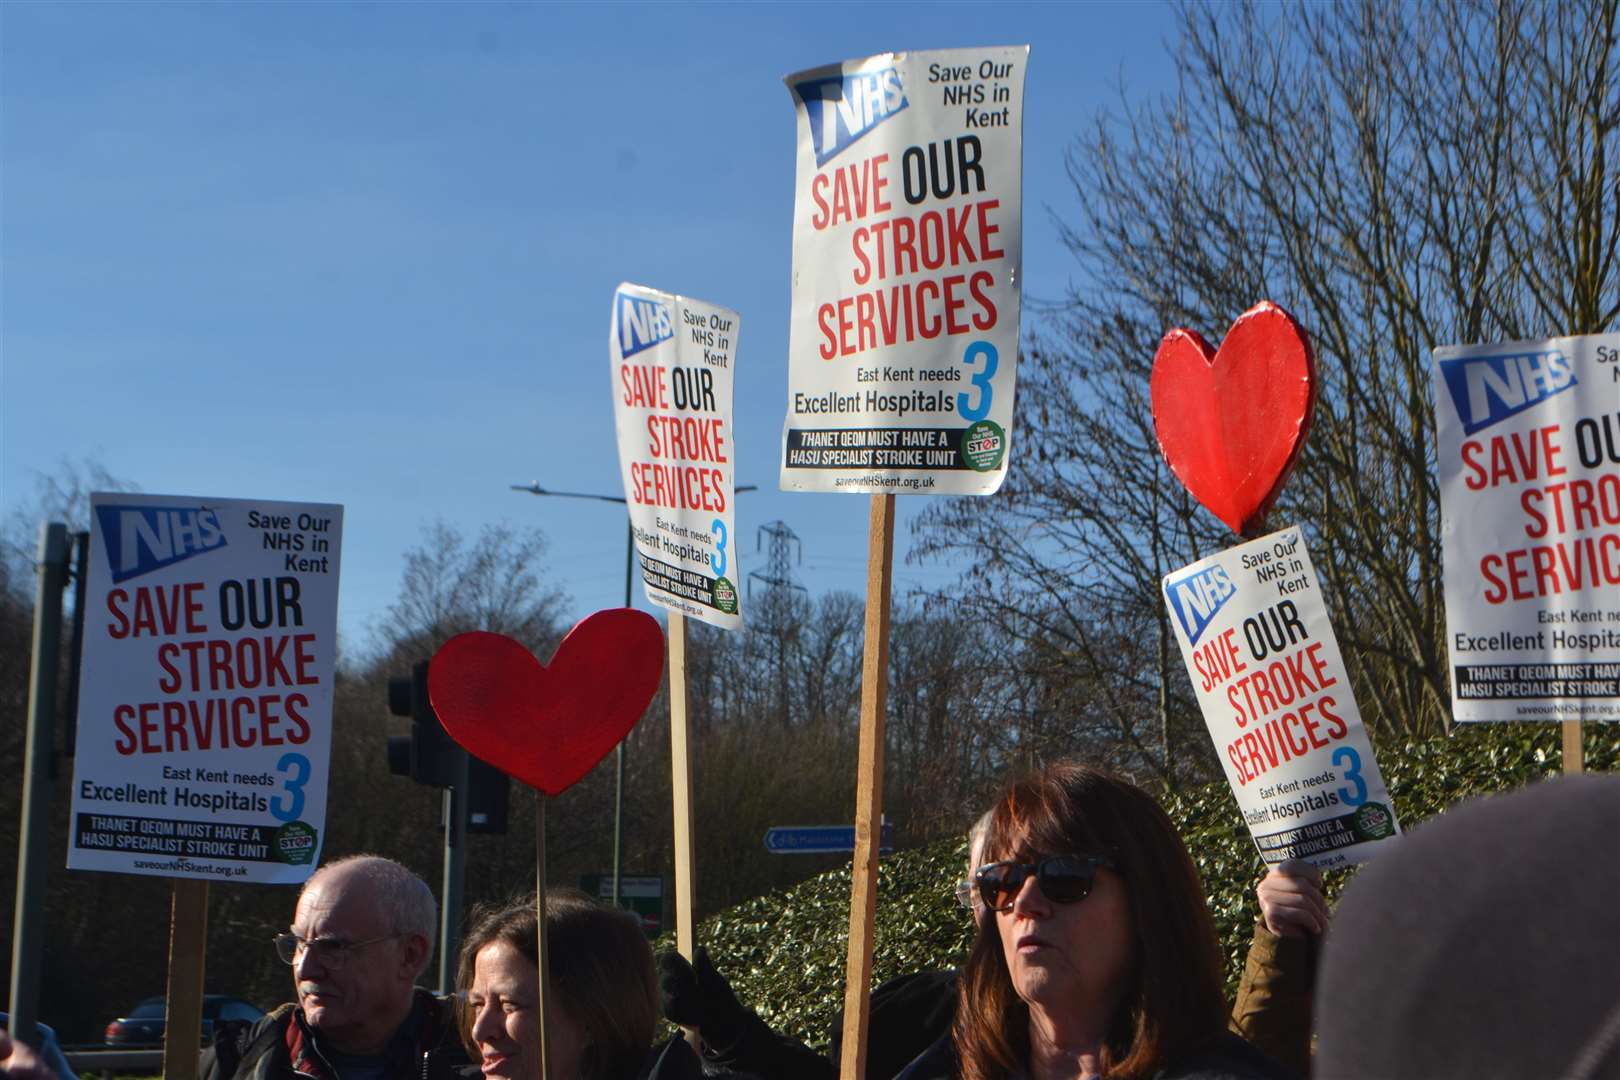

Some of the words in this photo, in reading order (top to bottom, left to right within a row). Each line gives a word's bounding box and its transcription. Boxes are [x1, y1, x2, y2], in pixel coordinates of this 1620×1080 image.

[928, 62, 975, 84] Save
[978, 59, 1014, 81] Our
[943, 84, 985, 107] NHS
[992, 82, 1010, 104] in
[819, 70, 904, 155] NHS
[966, 106, 1009, 130] Kent
[811, 153, 892, 230] SAVE
[903, 134, 987, 206] OUR
[852, 199, 1005, 287] STROKE
[622, 300, 672, 352] NHS
[683, 309, 707, 328] Save
[710, 315, 732, 333] Our
[818, 270, 998, 362] SERVICES
[691, 328, 714, 348] NHS
[719, 334, 729, 350] in
[704, 349, 728, 368] Kent
[1597, 345, 1618, 363] Sa
[857, 367, 879, 382] East
[883, 366, 914, 382] Kent
[919, 366, 961, 382] needs
[956, 340, 998, 422] 3
[1469, 352, 1572, 424] NHS
[621, 365, 669, 410] SAVE
[672, 367, 716, 412] OUR
[794, 392, 861, 414] Excellent
[866, 389, 954, 417] Hospitals
[647, 415, 727, 463] STROKE
[800, 432, 839, 448] THANET
[841, 431, 866, 447] QEQM
[868, 431, 899, 447] MUST
[902, 431, 936, 447] HAVE
[938, 431, 948, 447] A
[968, 438, 999, 453] STOP
[1460, 424, 1567, 491] SAVE
[1575, 412, 1620, 469] OU
[790, 450, 820, 465] HASU
[822, 450, 874, 466] SPECIALIST
[876, 450, 923, 466] STROKE
[926, 450, 957, 466] UNIT
[631, 462, 726, 513] SERVICES
[1520, 473, 1620, 539] STRO
[248, 510, 292, 531] Save
[296, 512, 330, 533] Our
[656, 517, 669, 531] East
[670, 521, 688, 537] Kent
[690, 530, 712, 545] needs
[119, 508, 223, 573] NHS
[263, 533, 305, 552] NHS
[312, 536, 329, 553] in
[663, 535, 710, 565] Hospitals
[710, 519, 727, 577] 3
[284, 554, 329, 574] Kent
[1241, 551, 1271, 569] Save
[1273, 543, 1297, 558] Our
[1480, 533, 1620, 605] SERVIC
[683, 570, 702, 587] HAVE
[703, 577, 709, 590] A
[1256, 562, 1286, 584] NHS
[1289, 559, 1303, 573] in
[1277, 574, 1310, 596] Kent
[671, 580, 697, 599] STROKE
[698, 588, 712, 605] UNIT
[1176, 565, 1234, 636] NHS
[107, 582, 207, 640] SAVE
[219, 576, 303, 631] OUR
[1538, 610, 1565, 624] East
[1570, 609, 1602, 623] Kent
[1193, 627, 1248, 693] SAVE
[1243, 599, 1309, 661] OUR
[1455, 631, 1545, 651] Excellent
[158, 634, 320, 694] STROKE
[1467, 666, 1516, 681] THANET
[1557, 665, 1592, 680] MUST
[1226, 641, 1337, 728] STROKE
[1461, 682, 1492, 697] HASU
[1496, 681, 1565, 697] SPECIALIST
[1568, 680, 1617, 695] STROKE
[113, 693, 311, 756] SERVICES
[1227, 696, 1348, 786] SERVICES
[163, 766, 191, 781] East
[196, 768, 229, 785] Kent
[233, 771, 275, 786] needs
[269, 752, 312, 822] 3
[1260, 786, 1275, 800] East
[1277, 780, 1299, 796] Kent
[1302, 771, 1336, 788] needs
[1332, 746, 1368, 807] 3
[80, 780, 167, 806] Excellent
[174, 787, 268, 813] Hospitals
[1271, 790, 1339, 820] Hospitals
[91, 816, 138, 833] THANET
[177, 823, 213, 839] MUST
[215, 826, 248, 841] HAVE
[251, 828, 261, 841] A
[1304, 821, 1334, 839] HAVE
[1336, 819, 1345, 831] A
[1331, 830, 1355, 847] UNIT
[81, 832, 117, 847] HASU
[118, 835, 184, 853] SPECIALIST
[187, 840, 237, 856] STROKE
[238, 844, 269, 859] UNIT
[280, 837, 312, 849] STOP
